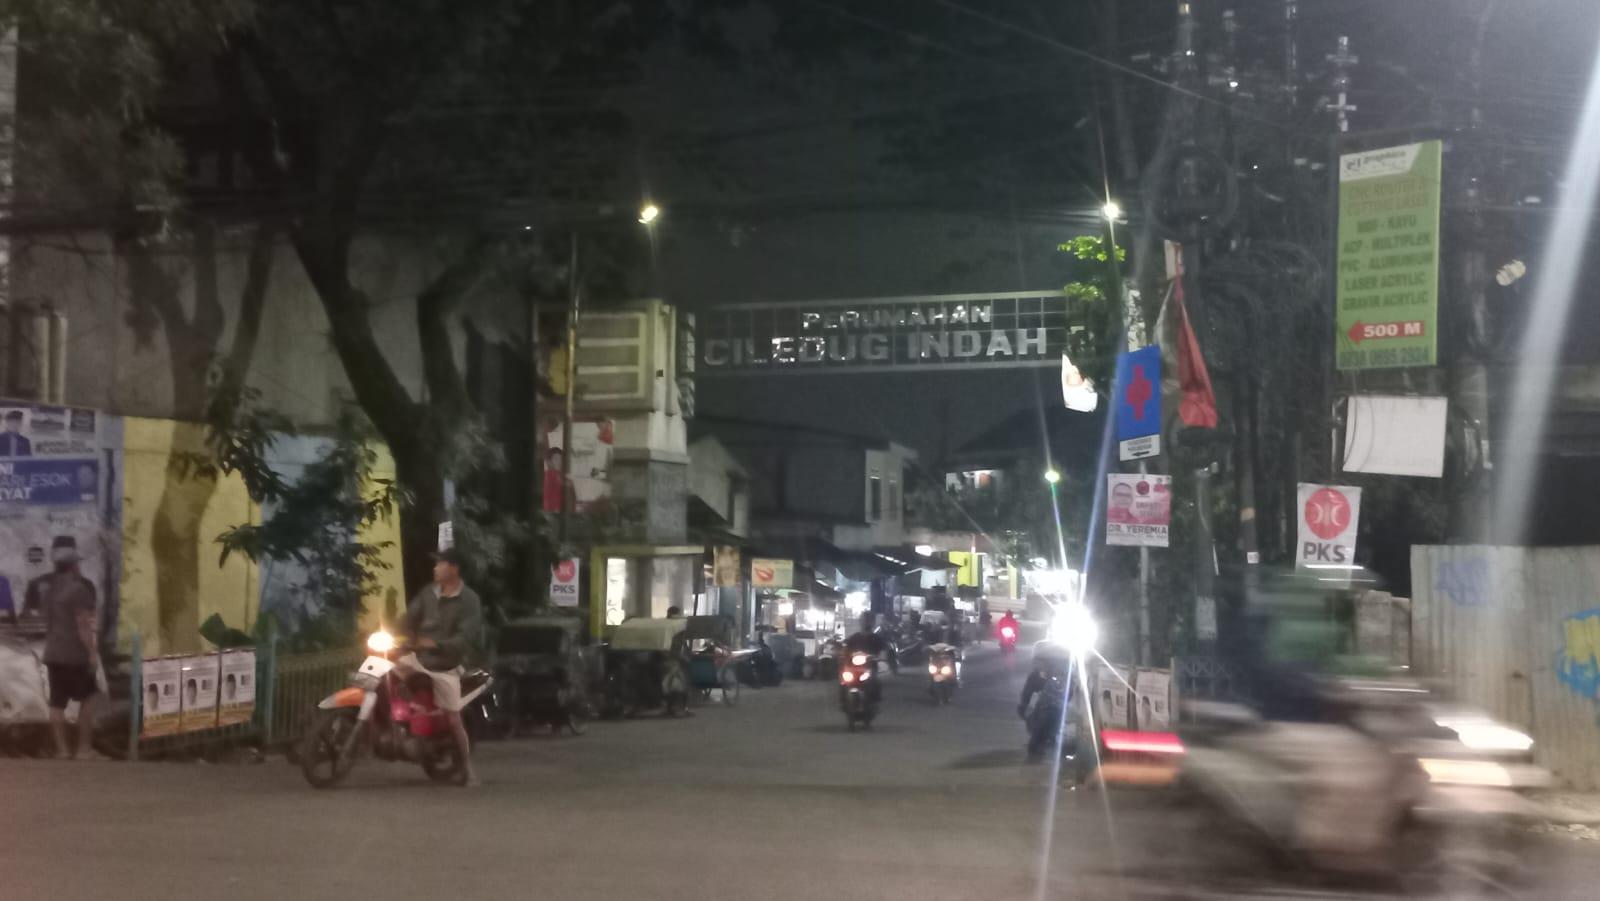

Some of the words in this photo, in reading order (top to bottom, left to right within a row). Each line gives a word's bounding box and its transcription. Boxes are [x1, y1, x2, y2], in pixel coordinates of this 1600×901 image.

[1344, 276, 1377, 291] LASER
[803, 305, 992, 329] PERUMAHAN
[1363, 324, 1399, 338] 500
[1404, 322, 1421, 335] M
[704, 334, 889, 365] CILEDUG
[908, 328, 1047, 359] INDAH
[1126, 525, 1168, 535] YEREMIA
[1303, 542, 1346, 563] PKS
[553, 584, 576, 594] PKS
